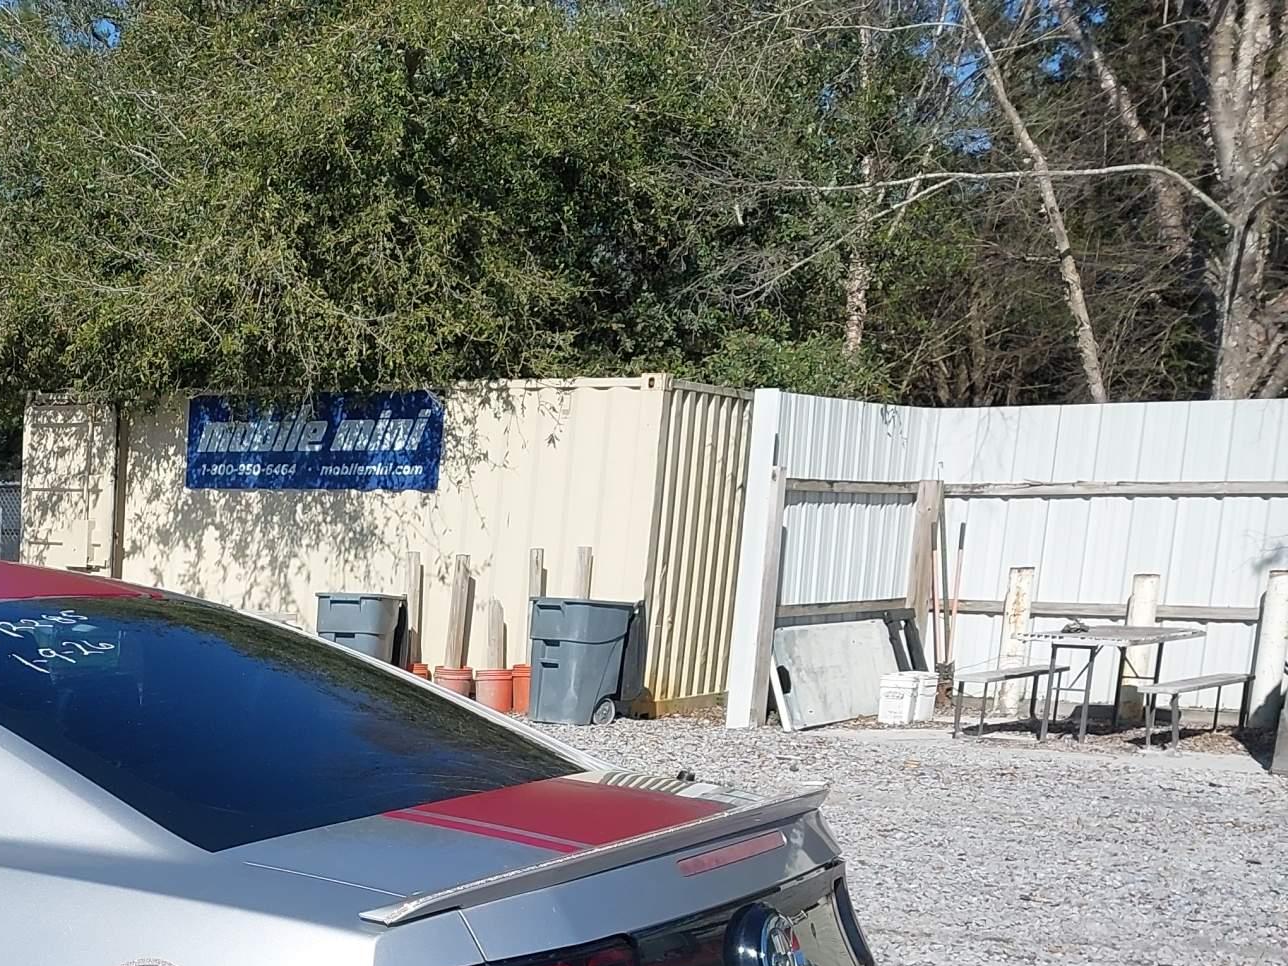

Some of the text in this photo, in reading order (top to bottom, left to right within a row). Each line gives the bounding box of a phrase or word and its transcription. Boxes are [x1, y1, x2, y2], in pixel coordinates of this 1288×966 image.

[330, 409, 431, 451] mini
[201, 463, 423, 475] 1-800-950-6464 mobilemini.com
